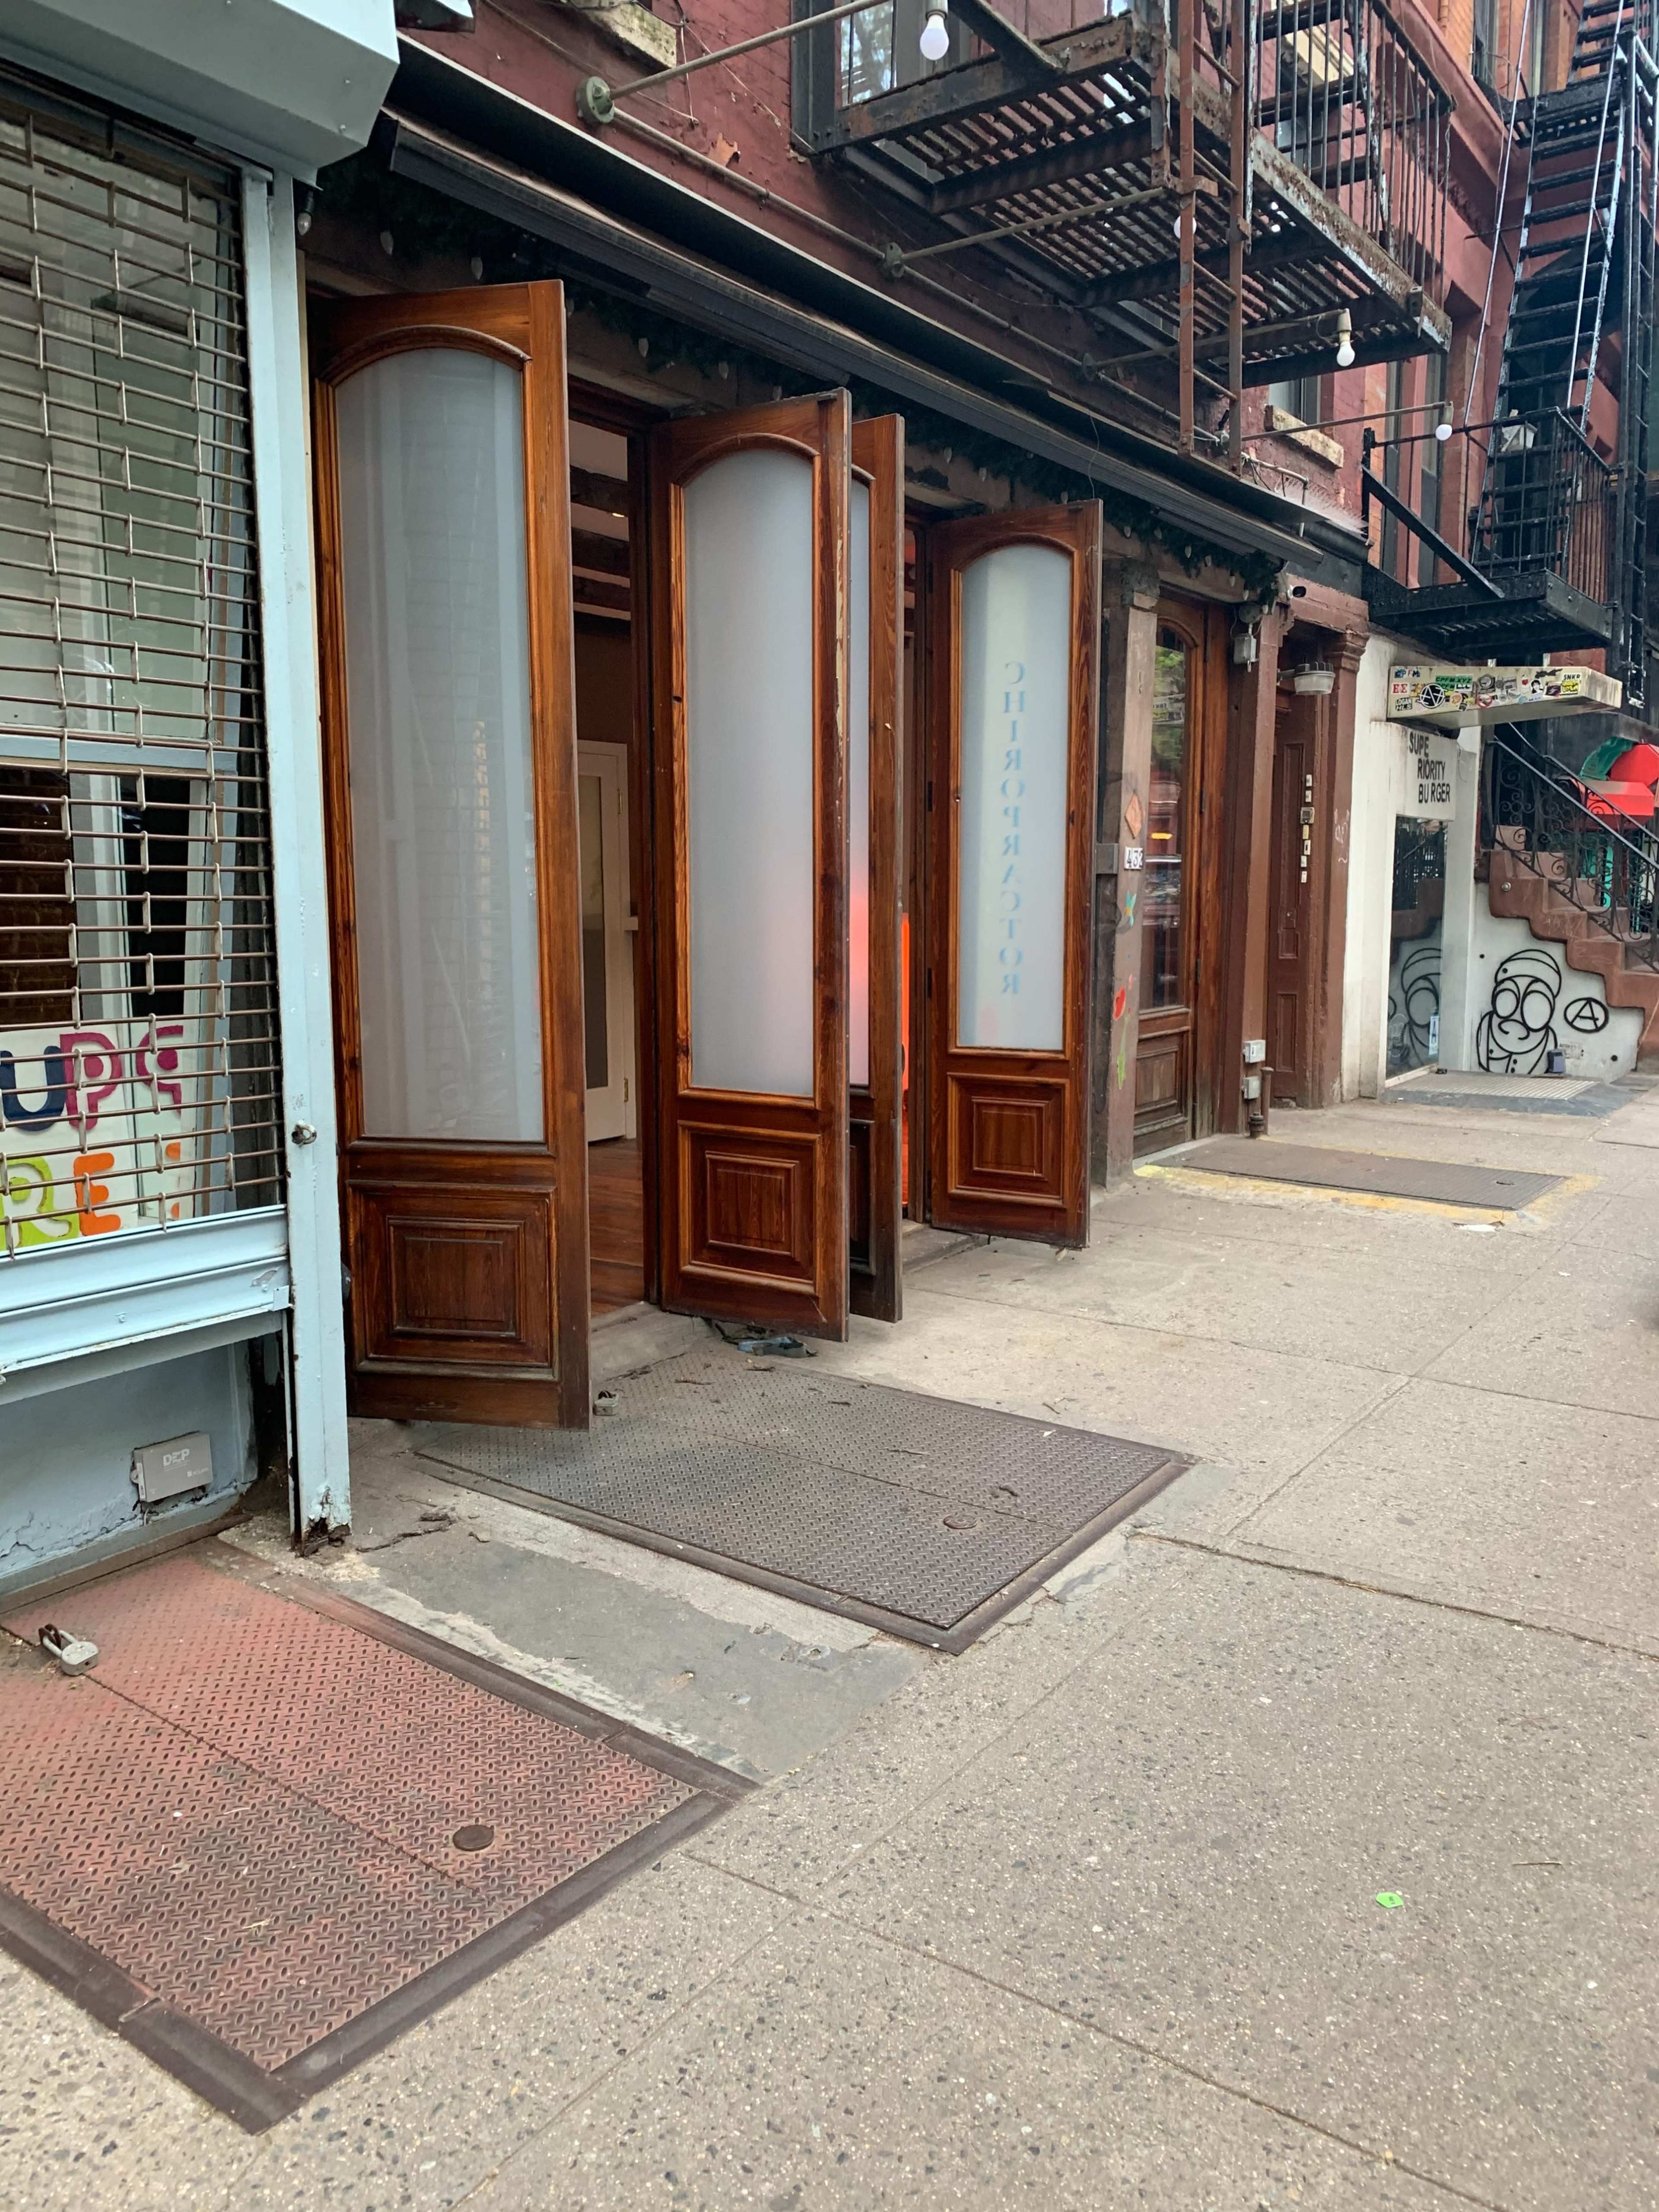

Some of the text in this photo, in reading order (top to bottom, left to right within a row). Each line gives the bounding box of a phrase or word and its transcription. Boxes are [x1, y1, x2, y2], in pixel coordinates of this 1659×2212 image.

[1409, 732, 1429, 758] SUPE
[1417, 758, 1445, 780] RIORITY
[1127, 849, 1144, 868] 432
[162, 1448, 190, 1467] DEP
